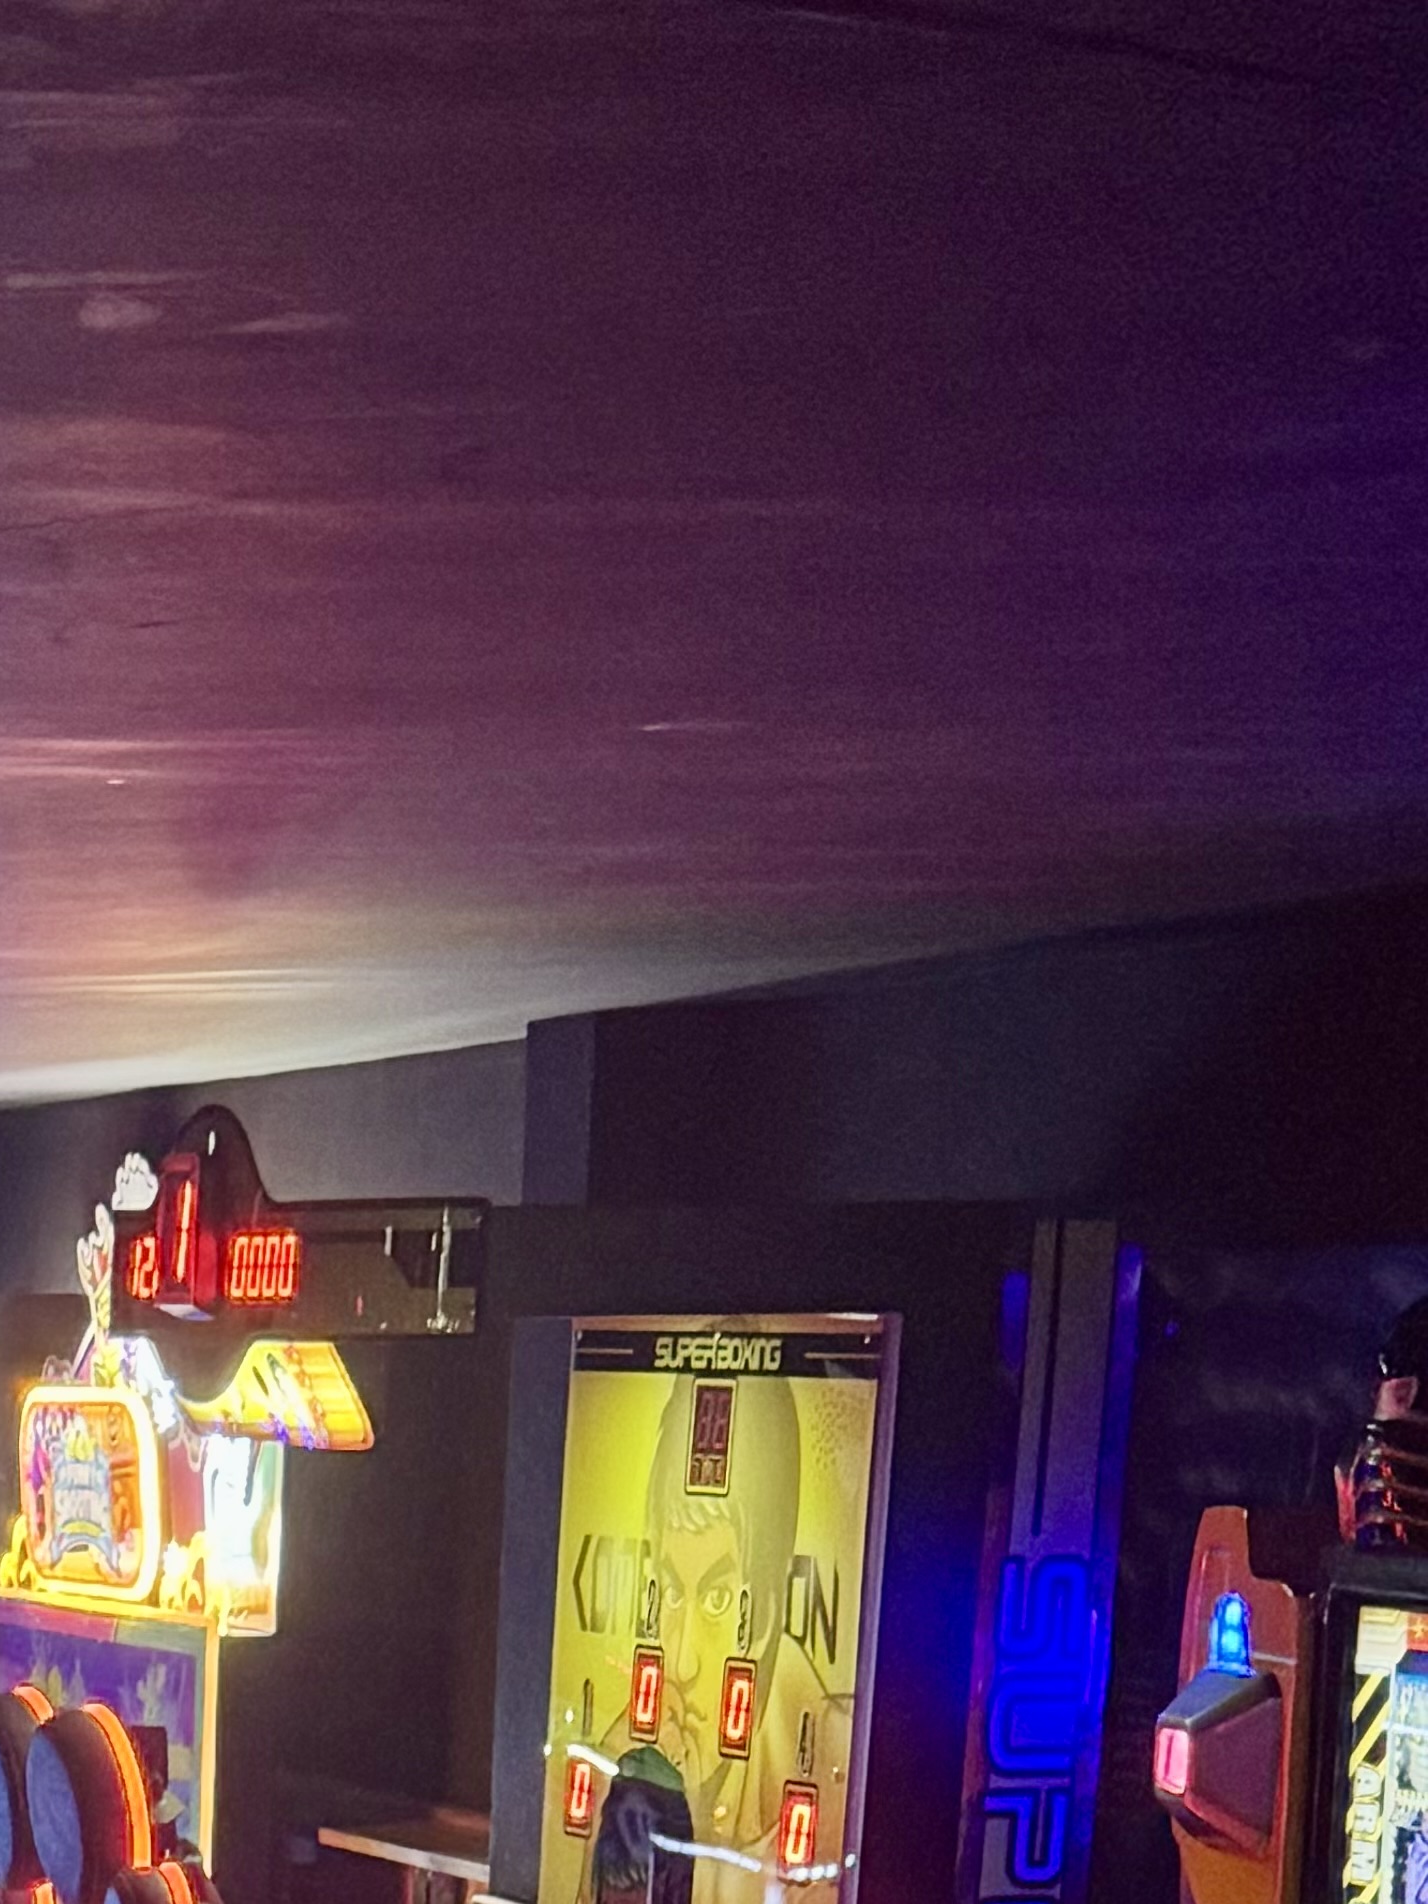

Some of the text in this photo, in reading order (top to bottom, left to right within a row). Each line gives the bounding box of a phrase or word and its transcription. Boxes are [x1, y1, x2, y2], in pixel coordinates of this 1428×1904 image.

[230, 1235, 296, 1298] 0000
[637, 1665, 657, 1723] 0
[727, 1678, 749, 1740] 0
[570, 1763, 590, 1818] 0
[785, 1803, 811, 1864] 0
